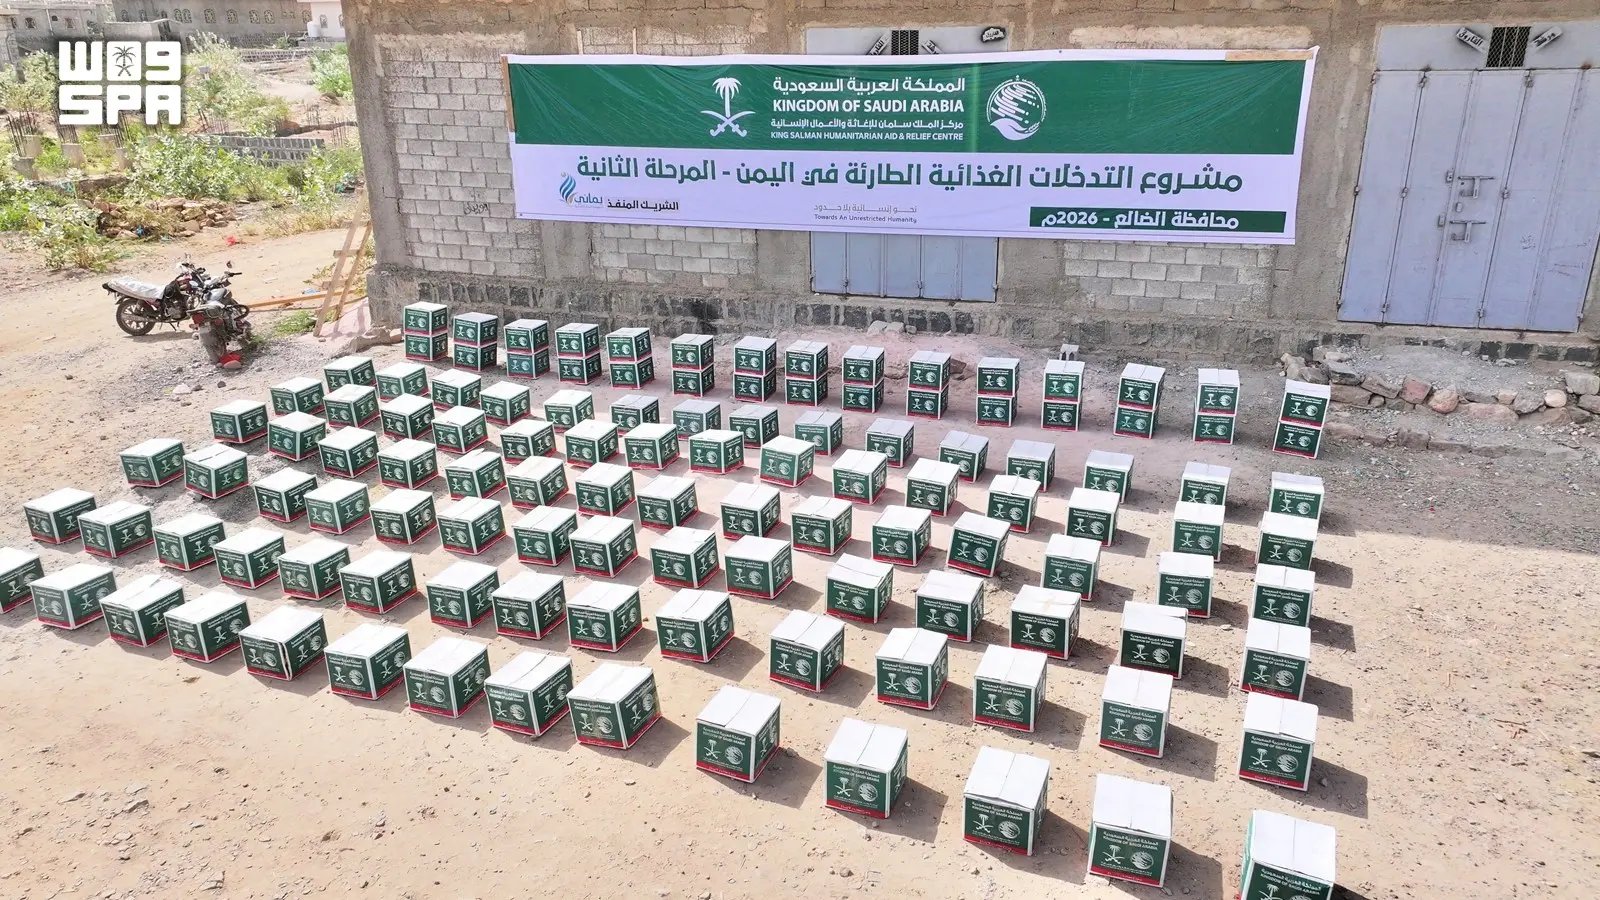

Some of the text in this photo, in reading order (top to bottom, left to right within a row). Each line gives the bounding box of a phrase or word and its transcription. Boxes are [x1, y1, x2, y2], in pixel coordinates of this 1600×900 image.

[773, 76, 965, 96] المملكة العربية السعودية
[773, 99, 965, 113] KINGDOM OF SAUDI ARABIA
[770, 118, 964, 130] مركز الملك سلمان للإغاثة والأعمال الإنسانية
[770, 131, 964, 140] KING SALMAN HUMANITARIAN AID & RELIEF CENTRE
[577, 154, 639, 181] الثانية
[645, 157, 716, 184] المرحلة
[736, 161, 795, 187] اليمن
[801, 162, 839, 186] في
[845, 162, 922, 190] الطارئة
[929, 163, 1022, 191] الغذائية
[1029, 163, 1134, 189] التدخلات
[1140, 163, 1243, 195] مشروع
[607, 198, 679, 212] الشريك المنفذ
[848, 214, 886, 222] Unrestricted
[887, 215, 917, 224] Humanity
[1041, 211, 1099, 227] 2026م
[1114, 210, 1166, 229] الضالع
[1171, 211, 1240, 230] محافظة
